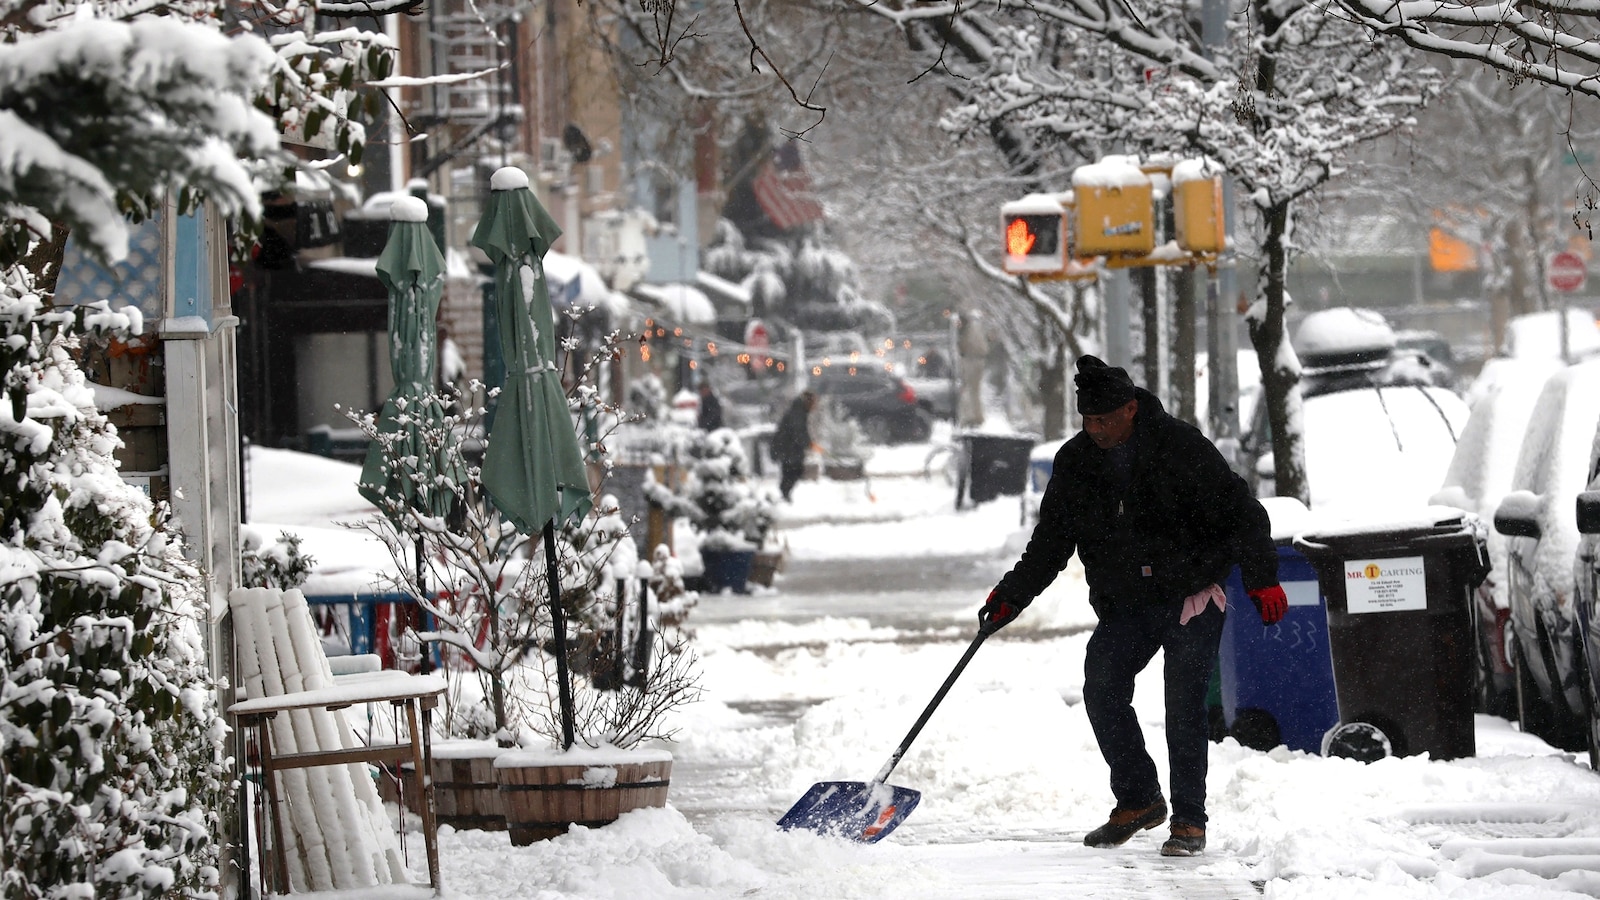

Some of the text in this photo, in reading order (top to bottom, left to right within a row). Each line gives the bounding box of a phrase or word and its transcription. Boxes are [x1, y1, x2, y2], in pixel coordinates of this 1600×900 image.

[1347, 566, 1422, 579] MR. T CARTING
